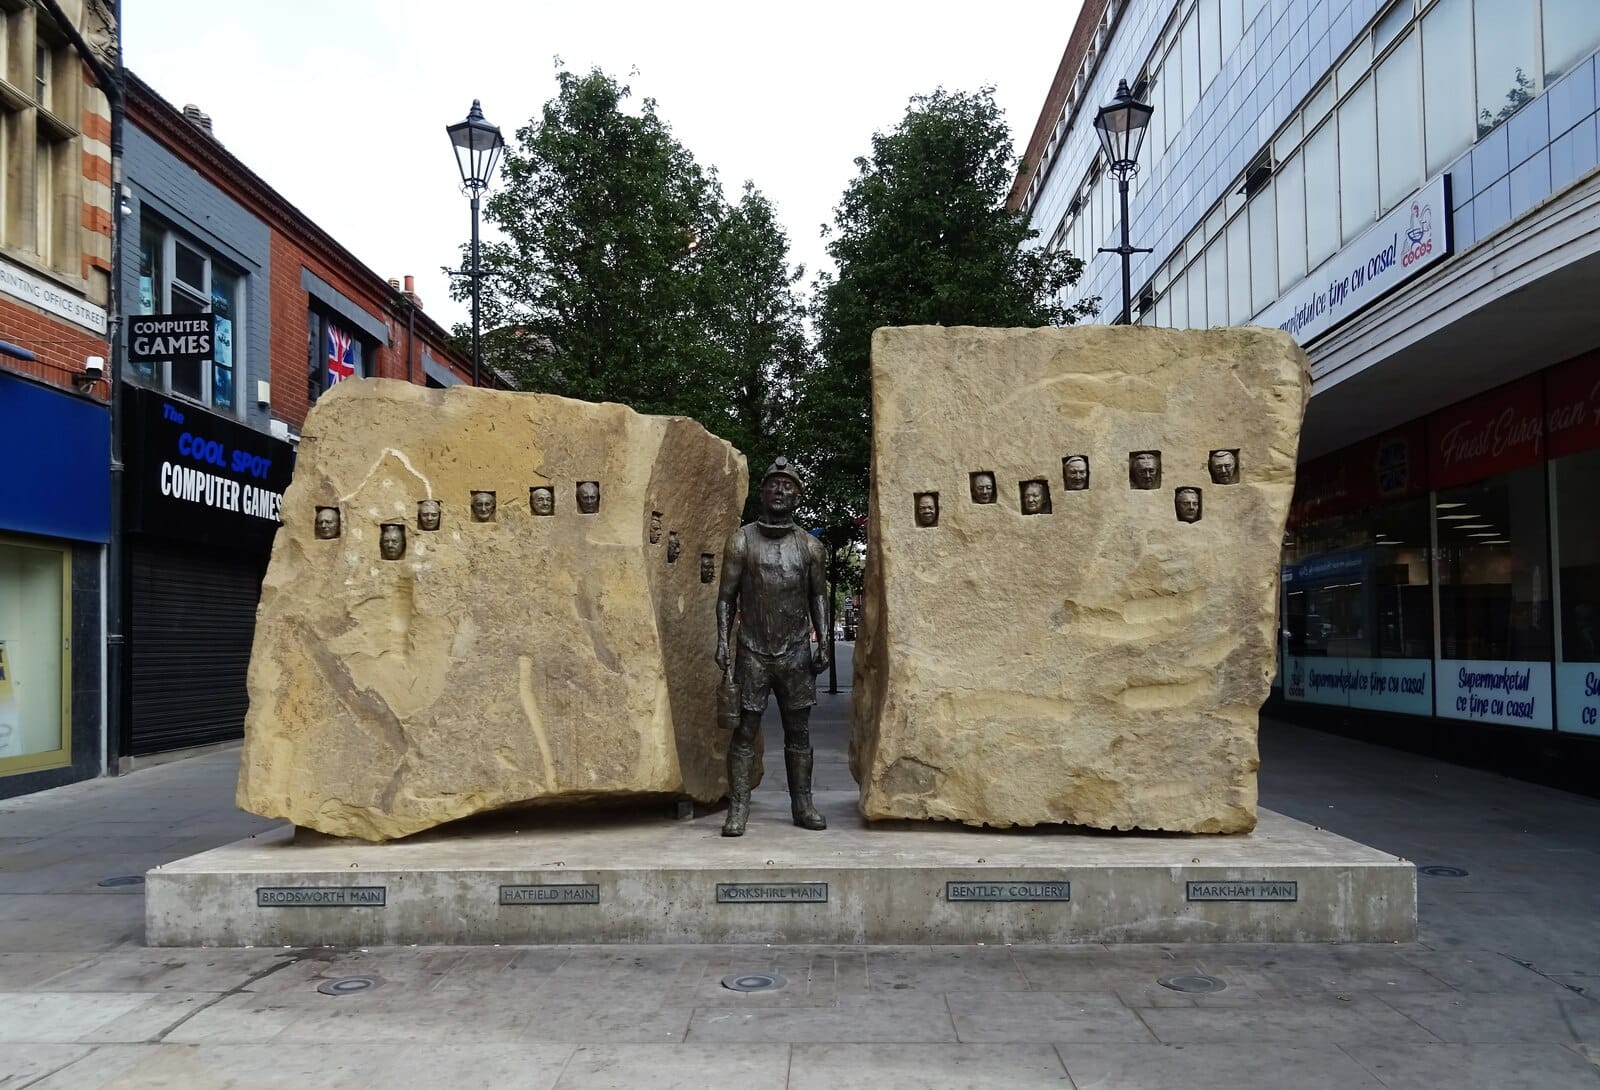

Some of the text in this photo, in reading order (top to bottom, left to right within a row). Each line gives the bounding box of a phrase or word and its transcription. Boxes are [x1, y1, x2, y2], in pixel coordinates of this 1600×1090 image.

[1351, 264, 1364, 292] cu
[1367, 233, 1397, 281] casa!
[43, 290, 73, 312] OFFICE
[75, 305, 105, 327] STREET
[134, 320, 209, 334] COMPUTER
[134, 336, 210, 355] GAMES
[163, 403, 184, 425] The
[1440, 417, 1491, 468] Finest
[1493, 400, 1586, 458] European
[178, 432, 272, 479] COOL SPOT
[161, 461, 283, 522] COMPUTER GAMES
[1388, 675, 1400, 694] cu
[1401, 672, 1426, 696] casa!
[1458, 667, 1530, 694] Supermarketul
[1456, 695, 1467, 712] ce
[1491, 699, 1503, 716] cu
[1507, 697, 1534, 719] casa!
[1582, 706, 1597, 725] ce
[262, 891, 381, 902] BRODSWORTH MAIN
[505, 888, 595, 900] HATFIELD MAIN
[721, 887, 822, 898] YORKSHIRE MAIN
[952, 885, 1066, 897] BENTLEY COLLIERY
[1192, 887, 1292, 897] MARKHAM MAIN
